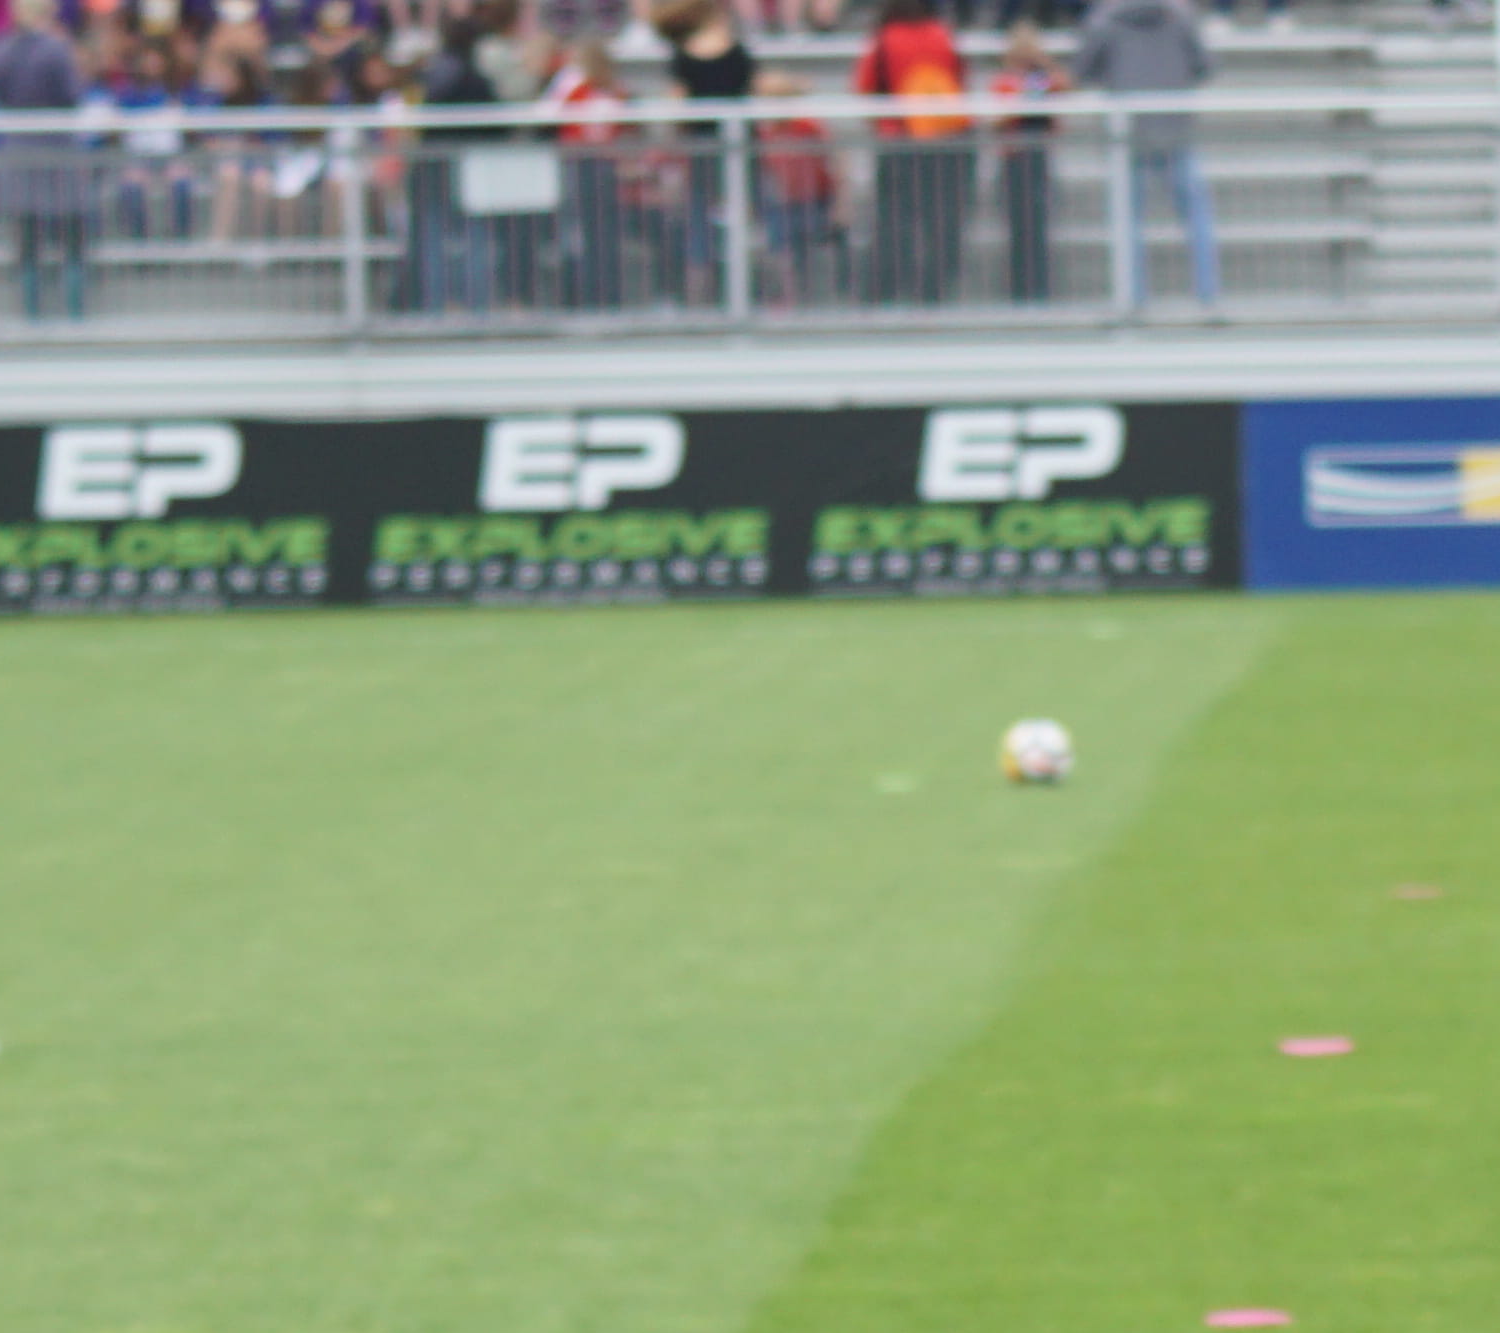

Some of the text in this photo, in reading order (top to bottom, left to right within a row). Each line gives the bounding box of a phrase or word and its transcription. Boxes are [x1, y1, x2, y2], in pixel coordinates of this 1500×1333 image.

[37, 423, 244, 520] EP
[478, 414, 684, 509] EP
[917, 406, 1126, 501] EP
[374, 513, 769, 556] EXPLOSIVE
[813, 503, 1208, 546] EXPLOSIVE
